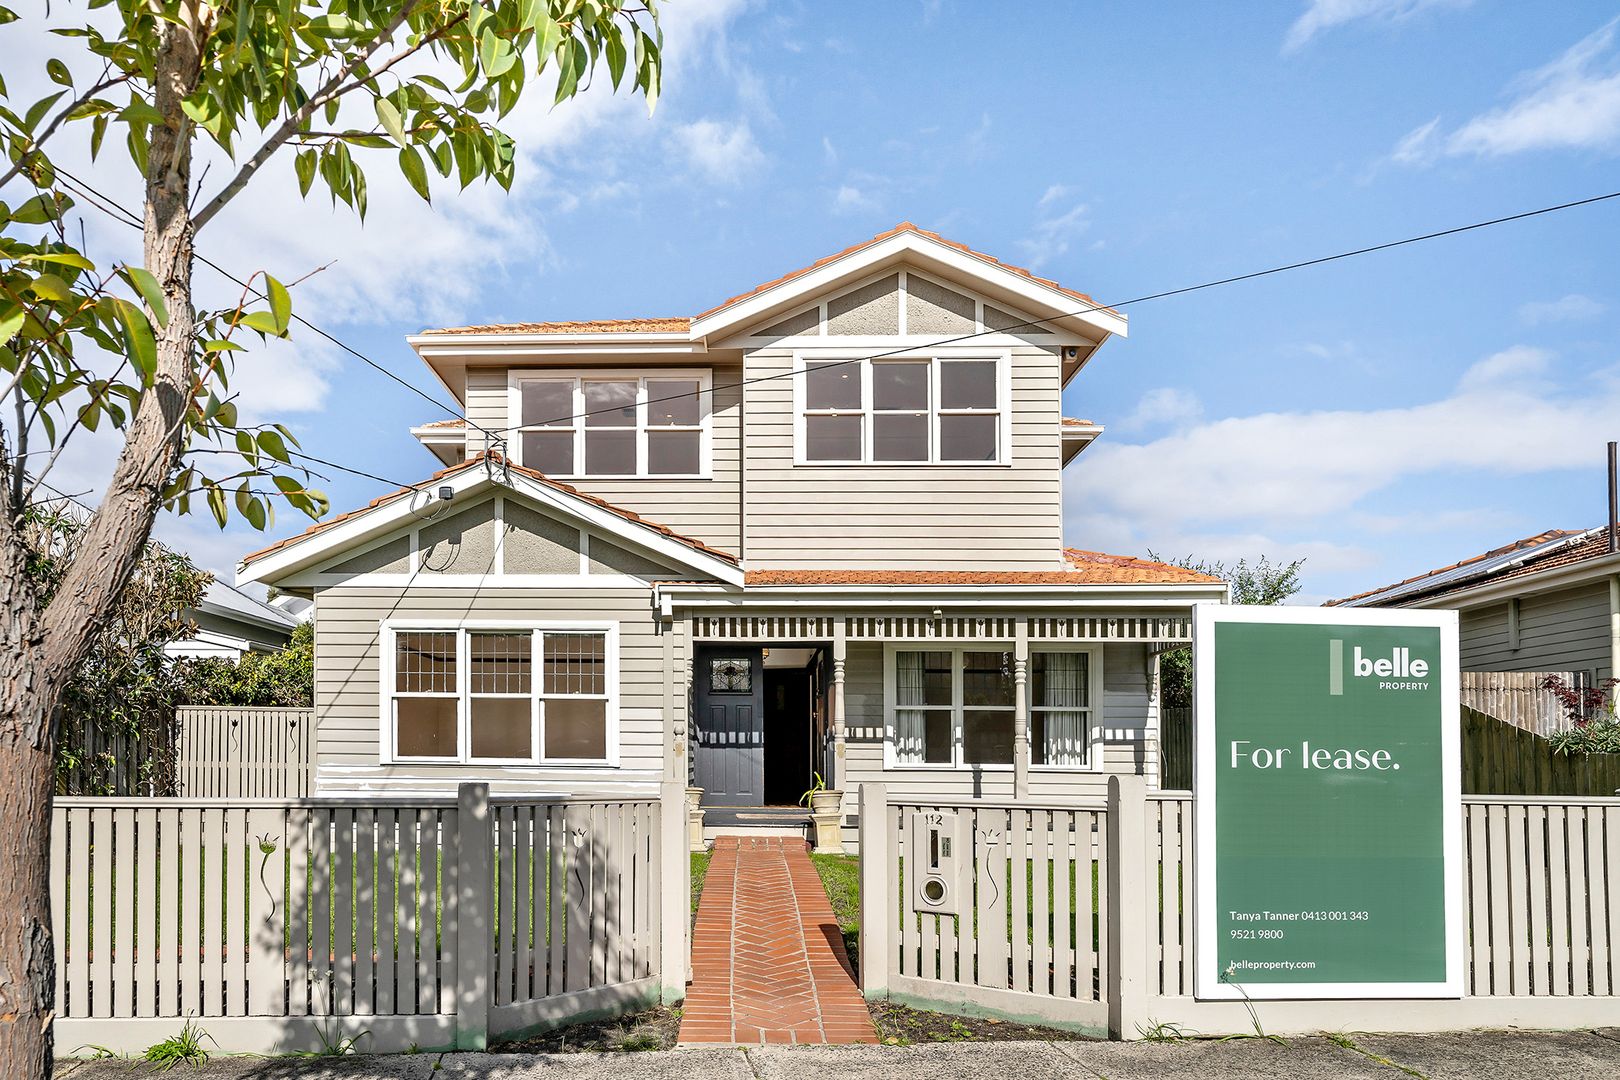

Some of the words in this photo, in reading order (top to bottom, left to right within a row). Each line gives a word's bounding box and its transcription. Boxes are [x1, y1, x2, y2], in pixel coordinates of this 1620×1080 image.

[1354, 646, 1429, 678] belle
[1379, 681, 1429, 690] PROPERTY
[1231, 740, 1292, 769] For
[1302, 741, 1400, 770] lease.
[1229, 911, 1261, 922] Tanya
[1263, 911, 1299, 921] Tanner
[1301, 911, 1327, 921] 0413
[1328, 911, 1348, 921] 001
[1350, 911, 1369, 921] 343
[1230, 929, 1255, 939] 9521
[1258, 929, 1284, 939] 9800
[1230, 960, 1316, 970] belleproperty.com
